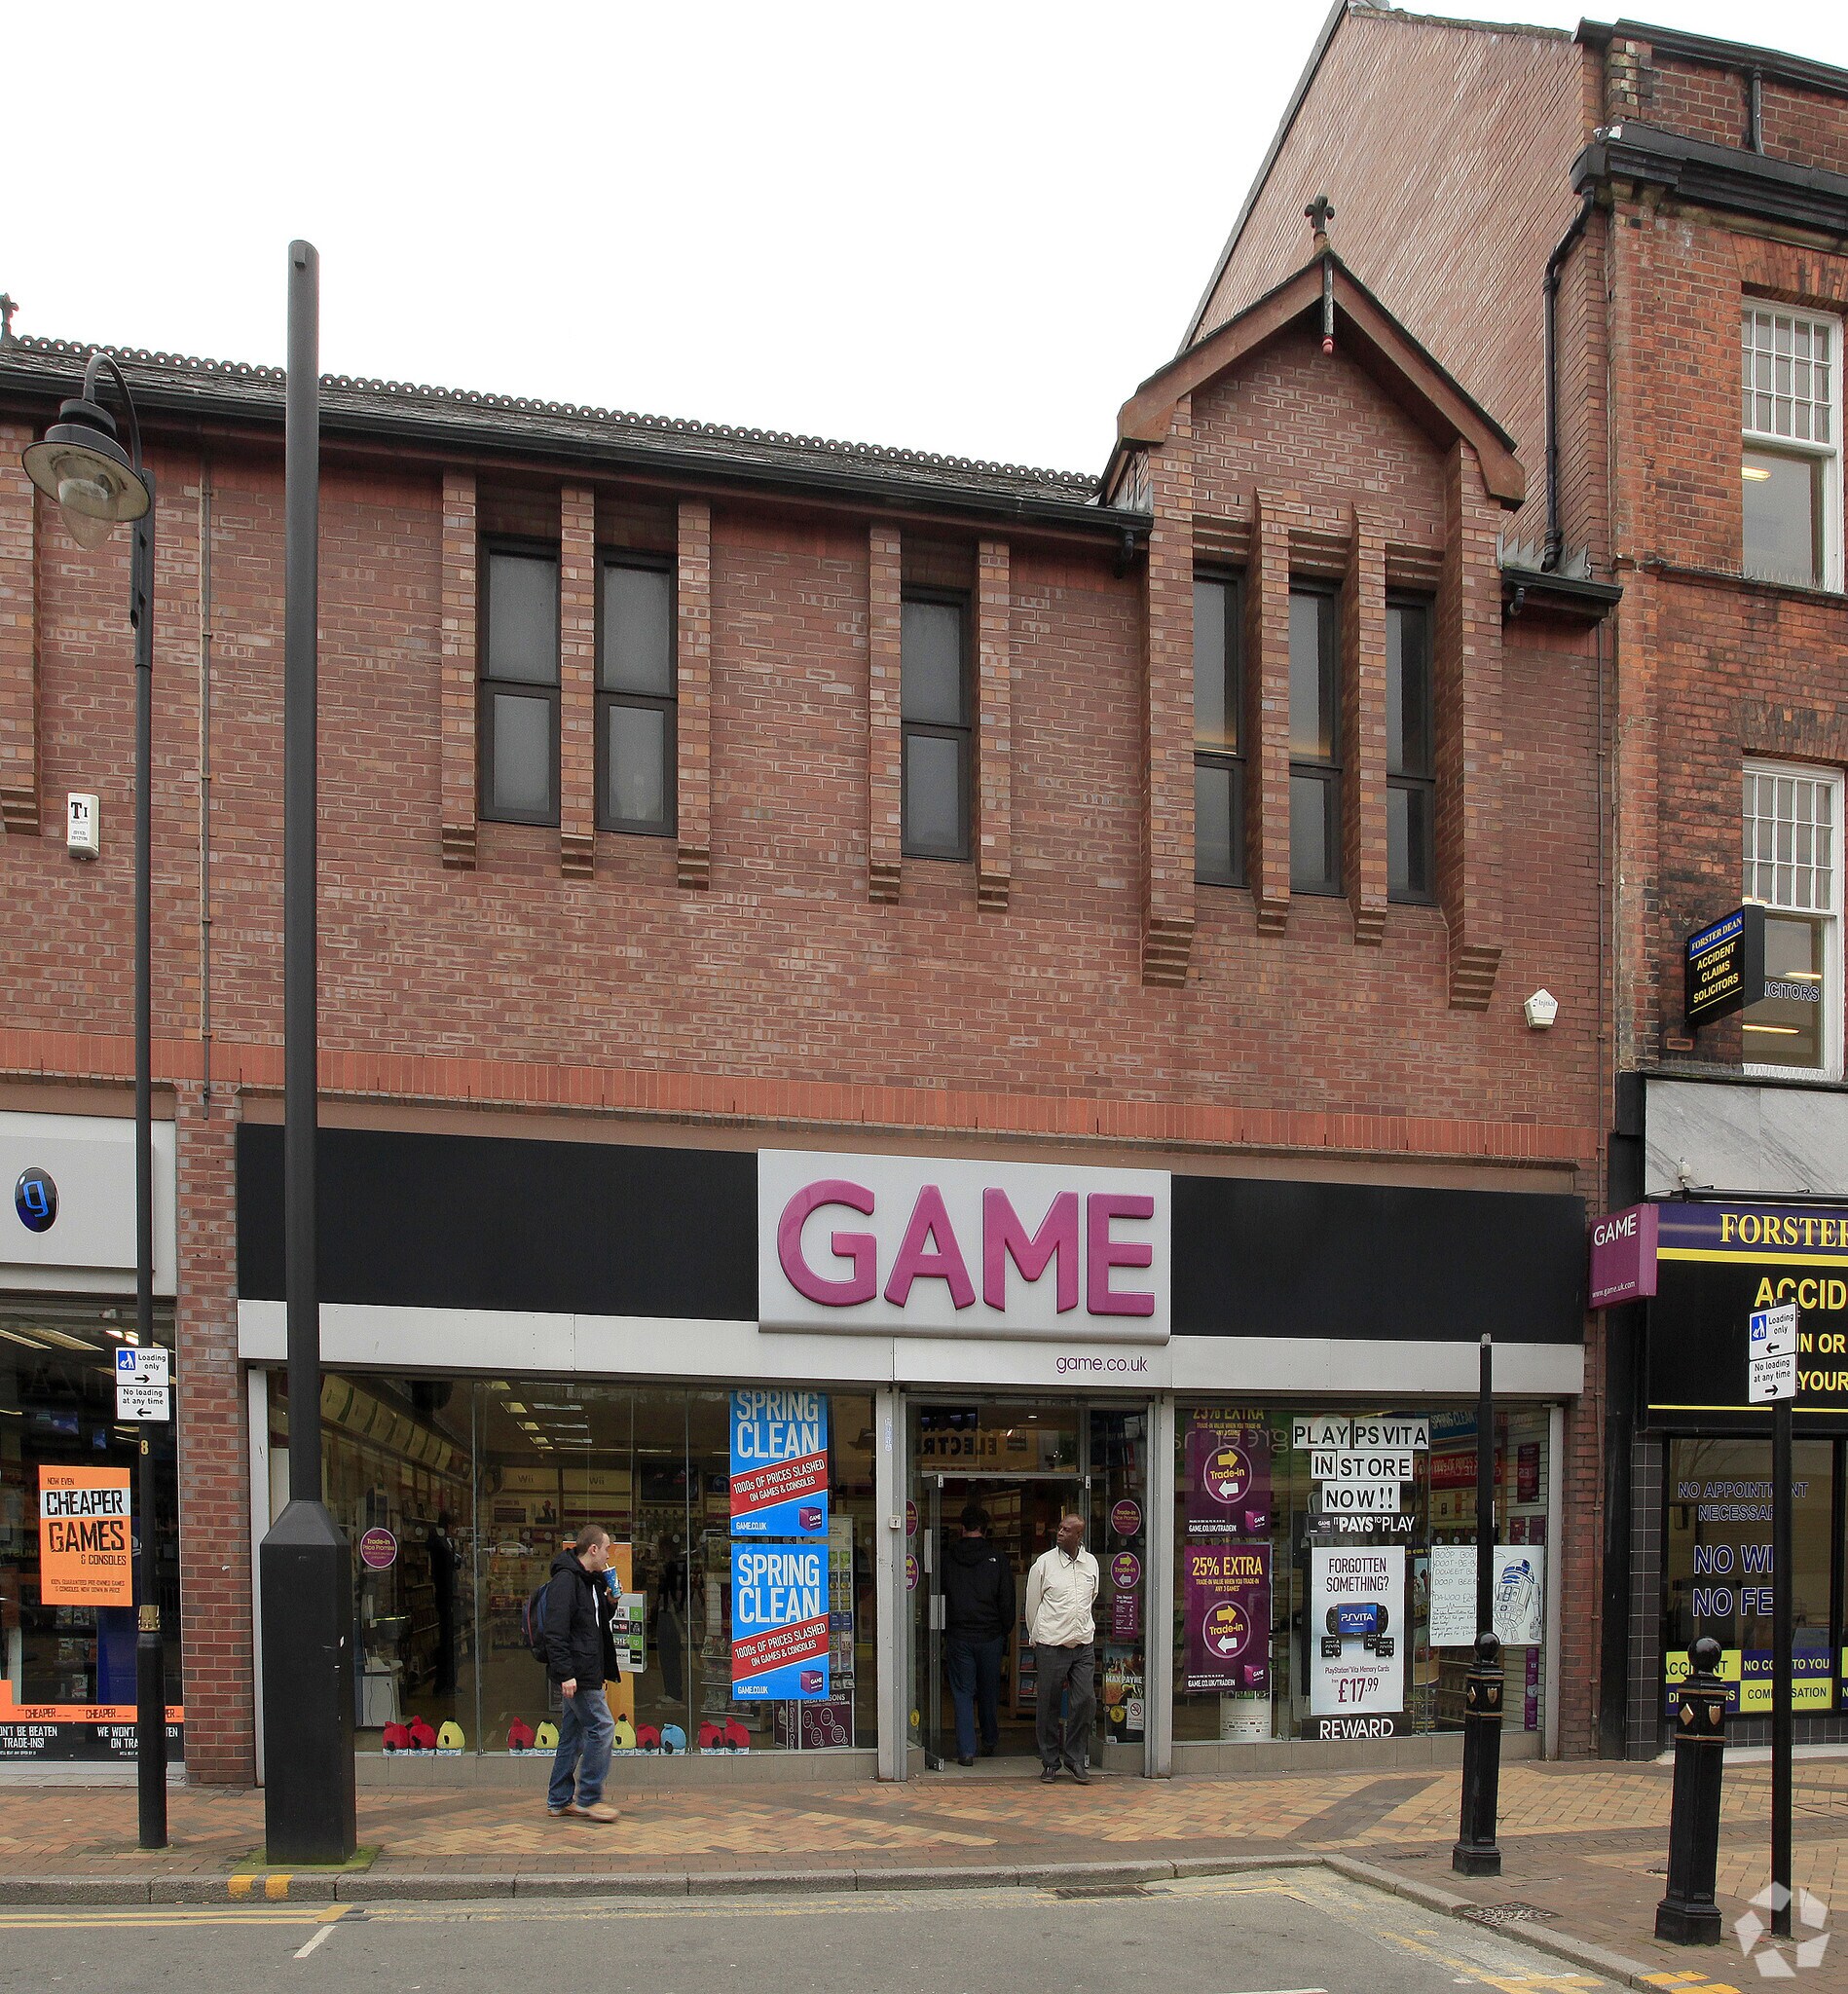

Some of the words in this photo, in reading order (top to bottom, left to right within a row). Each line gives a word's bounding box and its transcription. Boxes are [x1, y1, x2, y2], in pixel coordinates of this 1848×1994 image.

[1691, 929, 1721, 951] FORSTER
[1722, 916, 1743, 935] DEAN
[1696, 942, 1736, 972] ACCIDENT
[1702, 960, 1730, 983] CLAIMS
[1693, 973, 1739, 1004] SOLICITORS
[1764, 981, 1819, 1003] ICITORS
[1594, 1212, 1638, 1247] GAME
[776, 1178, 1156, 1317] GAME
[1768, 1313, 1793, 1324] Loading
[1818, 1333, 1846, 1353] OR
[138, 1354, 166, 1363] Loading
[1055, 1355, 1149, 1374] game.co.uk
[1755, 1363, 1764, 1372] No
[1765, 1359, 1791, 1369] loading
[1762, 1373, 1774, 1383] any
[1797, 1371, 1848, 1391] YOUR
[136, 1388, 164, 1397] loading
[736, 1390, 818, 1422] SPRING
[737, 1422, 819, 1459] CLEAN
[1295, 1425, 1349, 1445] PLAY
[140, 1439, 149, 1455] 8
[1209, 1467, 1244, 1480] Trade-in
[1314, 1457, 1332, 1474] IN
[1340, 1459, 1410, 1476] STORE
[588, 1476, 604, 1485] Wii
[733, 1480, 756, 1495] 1000s
[756, 1476, 765, 1488] OF
[766, 1468, 793, 1486] PRICES
[793, 1459, 826, 1477] SLASHED
[750, 1492, 759, 1502] ON
[759, 1486, 780, 1499] GAMES
[780, 1485, 787, 1494] &
[787, 1476, 816, 1492] CONSOLES
[1326, 1487, 1393, 1509] NOW!!
[1679, 1482, 1700, 1497] NO
[1704, 1482, 1809, 1497] APPOINTNT
[47, 1490, 125, 1515] CHEAPER
[1698, 1505, 1774, 1521] NECESSA
[1340, 1517, 1374, 1532] PAYS
[1383, 1517, 1415, 1532] PLAY
[49, 1520, 125, 1553] GAMES
[88, 1556, 127, 1566] CONSOLES
[1192, 1556, 1219, 1575] 25%
[1223, 1556, 1263, 1575] EXTRA
[1328, 1558, 1386, 1573] FORGOTTEN
[1694, 1544, 1734, 1574] NO
[1741, 1544, 1773, 1573] WI
[738, 1554, 820, 1587] SPRING
[1326, 1575, 1389, 1593] SOMETHING?
[738, 1587, 821, 1624] CLEAN
[1692, 1587, 1733, 1617] NO
[1741, 1587, 1773, 1616] FE
[1209, 1623, 1244, 1636] Trade-in
[734, 1645, 758, 1659] 1000s
[758, 1642, 767, 1652] OF
[767, 1634, 794, 1649] PRICES
[794, 1623, 826, 1642] SLASHED
[751, 1656, 759, 1667] ON
[760, 1651, 781, 1664] GAMES
[788, 1640, 817, 1656] CONSOLES
[1744, 1660, 1759, 1671] NO
[1792, 1659, 1805, 1670] TO
[1809, 1658, 1830, 1669] YOU
[1338, 1677, 1379, 1702] £17.99
[1747, 1686, 1827, 1700] COMSATION
[25, 1708, 56, 1719] CHEAPER
[86, 1708, 117, 1719] CHEAPER
[18, 1726, 27, 1737] BE
[29, 1726, 57, 1737] BEATEN
[97, 1727, 109, 1737] WE
[112, 1727, 134, 1737] WON'T
[1320, 1718, 1394, 1739] REWARD
[3, 1737, 45, 1749] TRADE-INS!
[111, 1738, 123, 1749] ON
